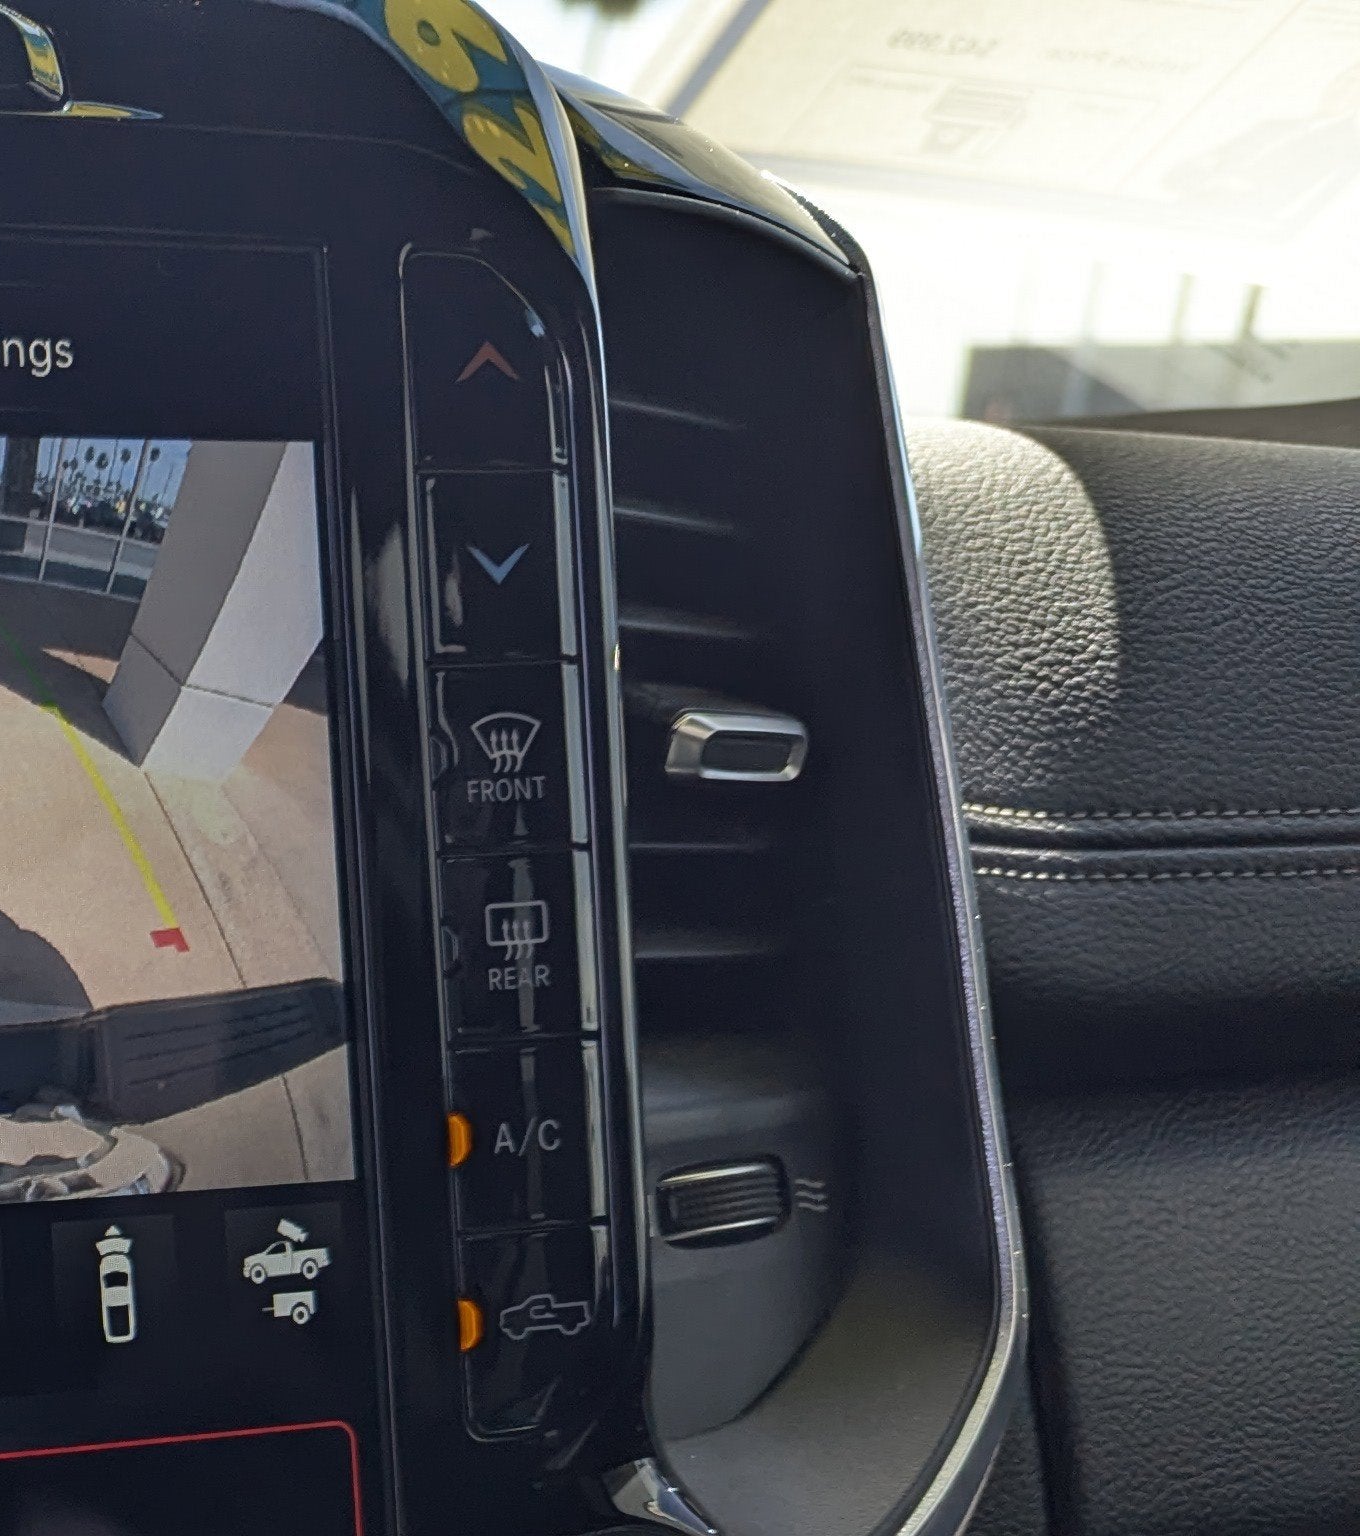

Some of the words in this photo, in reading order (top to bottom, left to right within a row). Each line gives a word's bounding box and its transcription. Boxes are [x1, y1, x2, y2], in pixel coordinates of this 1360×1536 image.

[467, 776, 546, 803] FRONT
[488, 964, 551, 991] REAR
[494, 1117, 561, 1156] A/C
